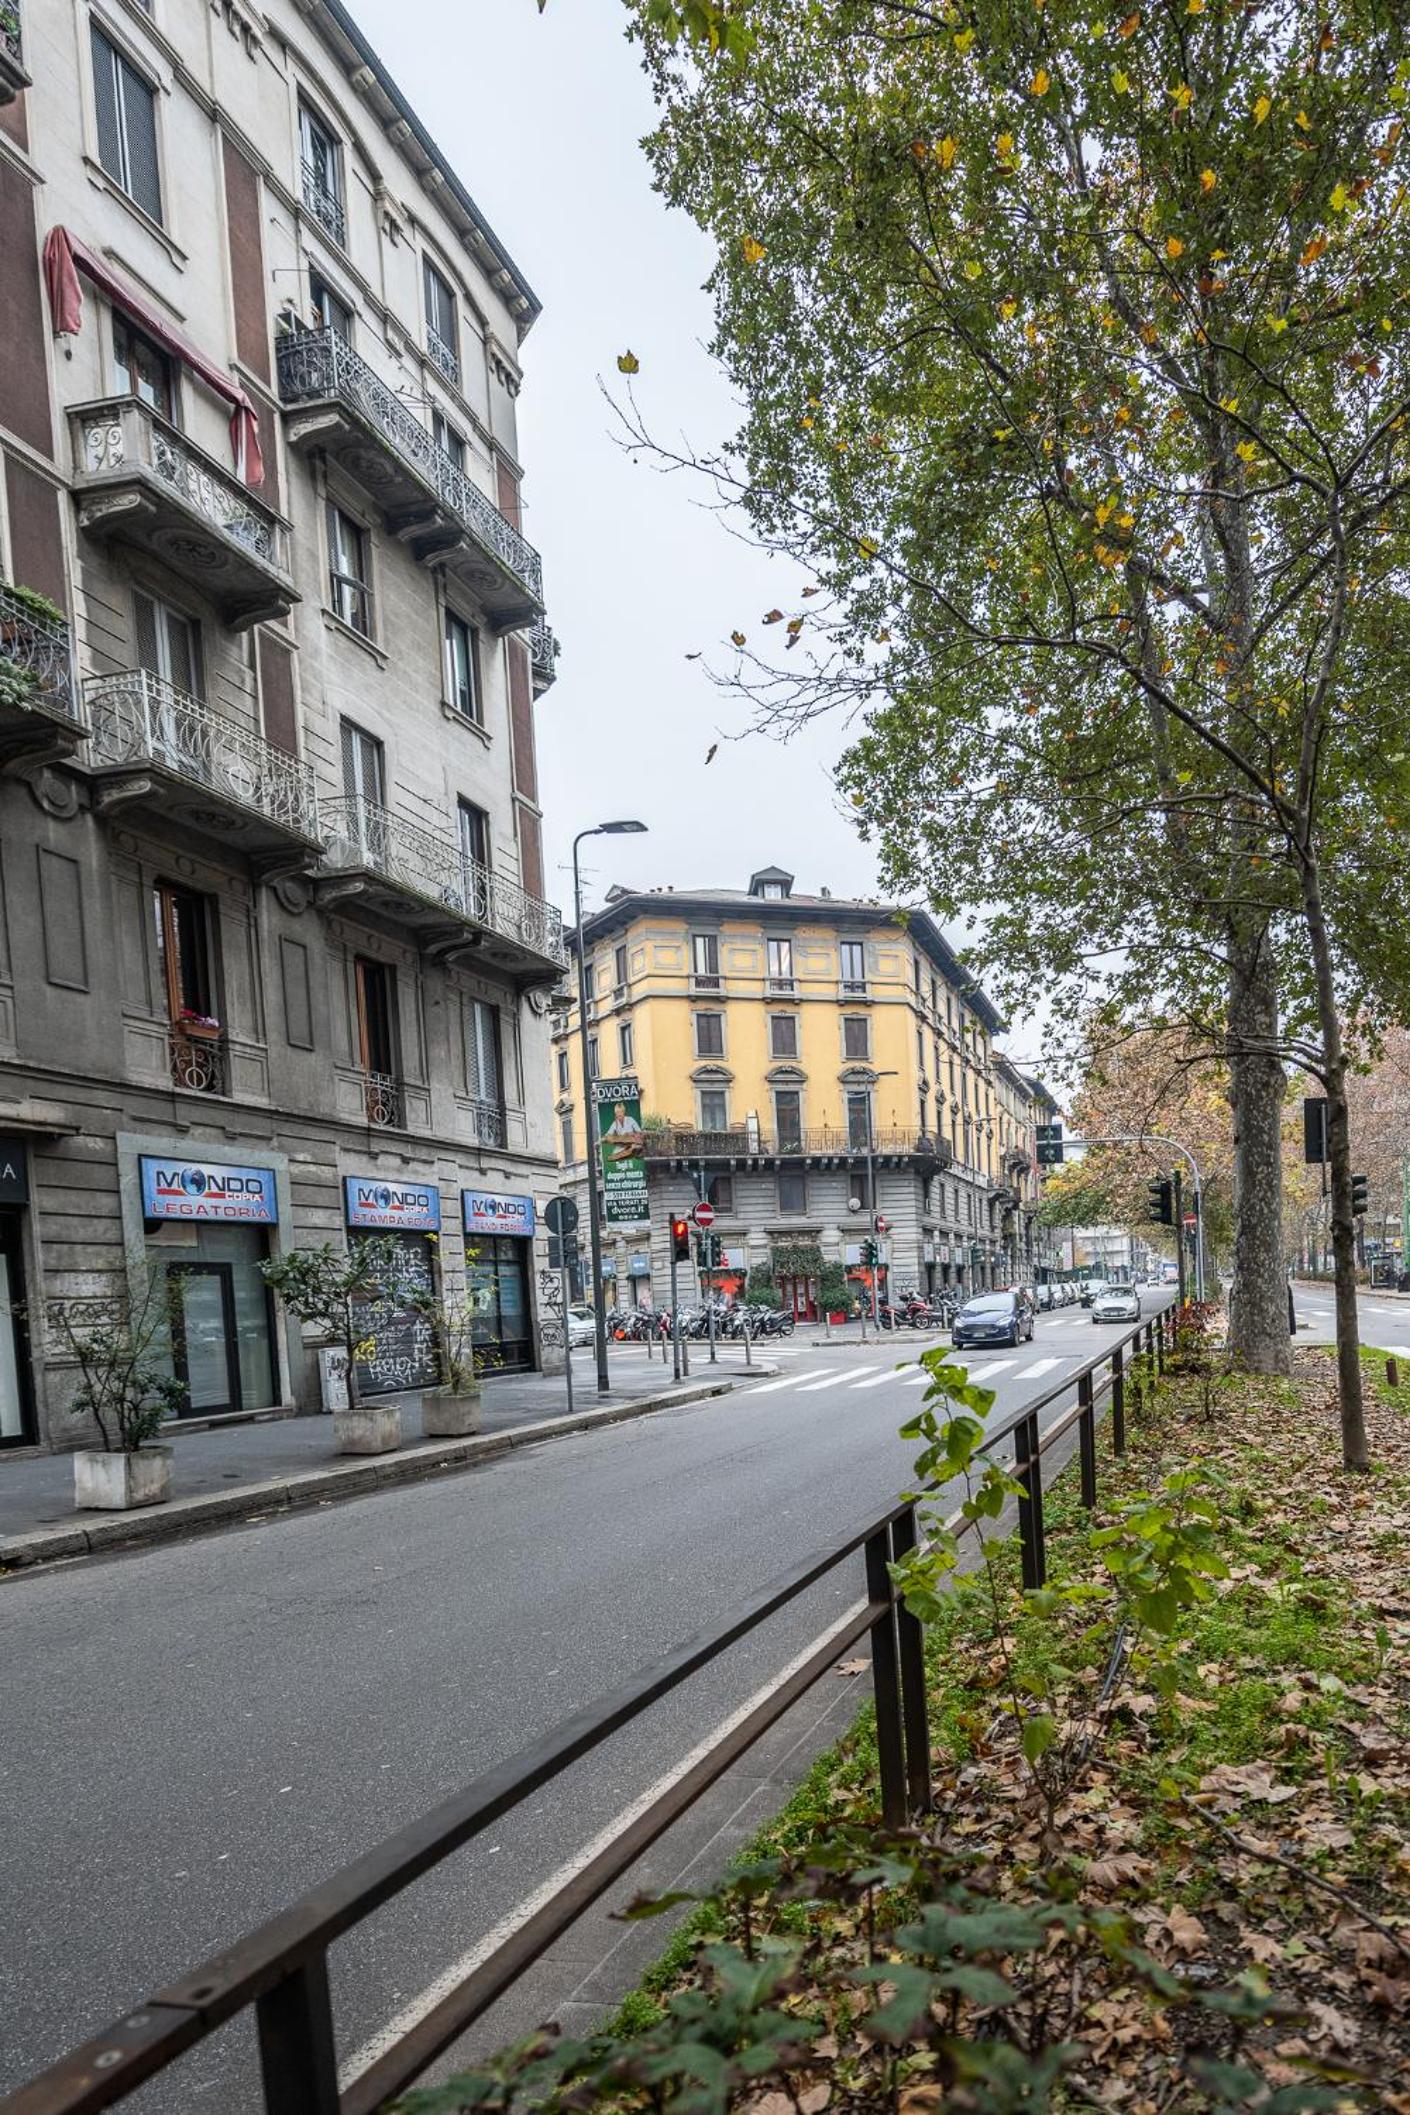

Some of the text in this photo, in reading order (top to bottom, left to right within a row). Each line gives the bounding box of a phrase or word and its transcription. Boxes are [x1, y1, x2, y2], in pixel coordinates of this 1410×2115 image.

[598, 1085, 638, 1098] DVORA
[2, 1163, 17, 1180] A
[225, 1193, 261, 1202] COPIA
[151, 1201, 271, 1219] LEGATORIA
[353, 1213, 404, 1226] STAMPA
